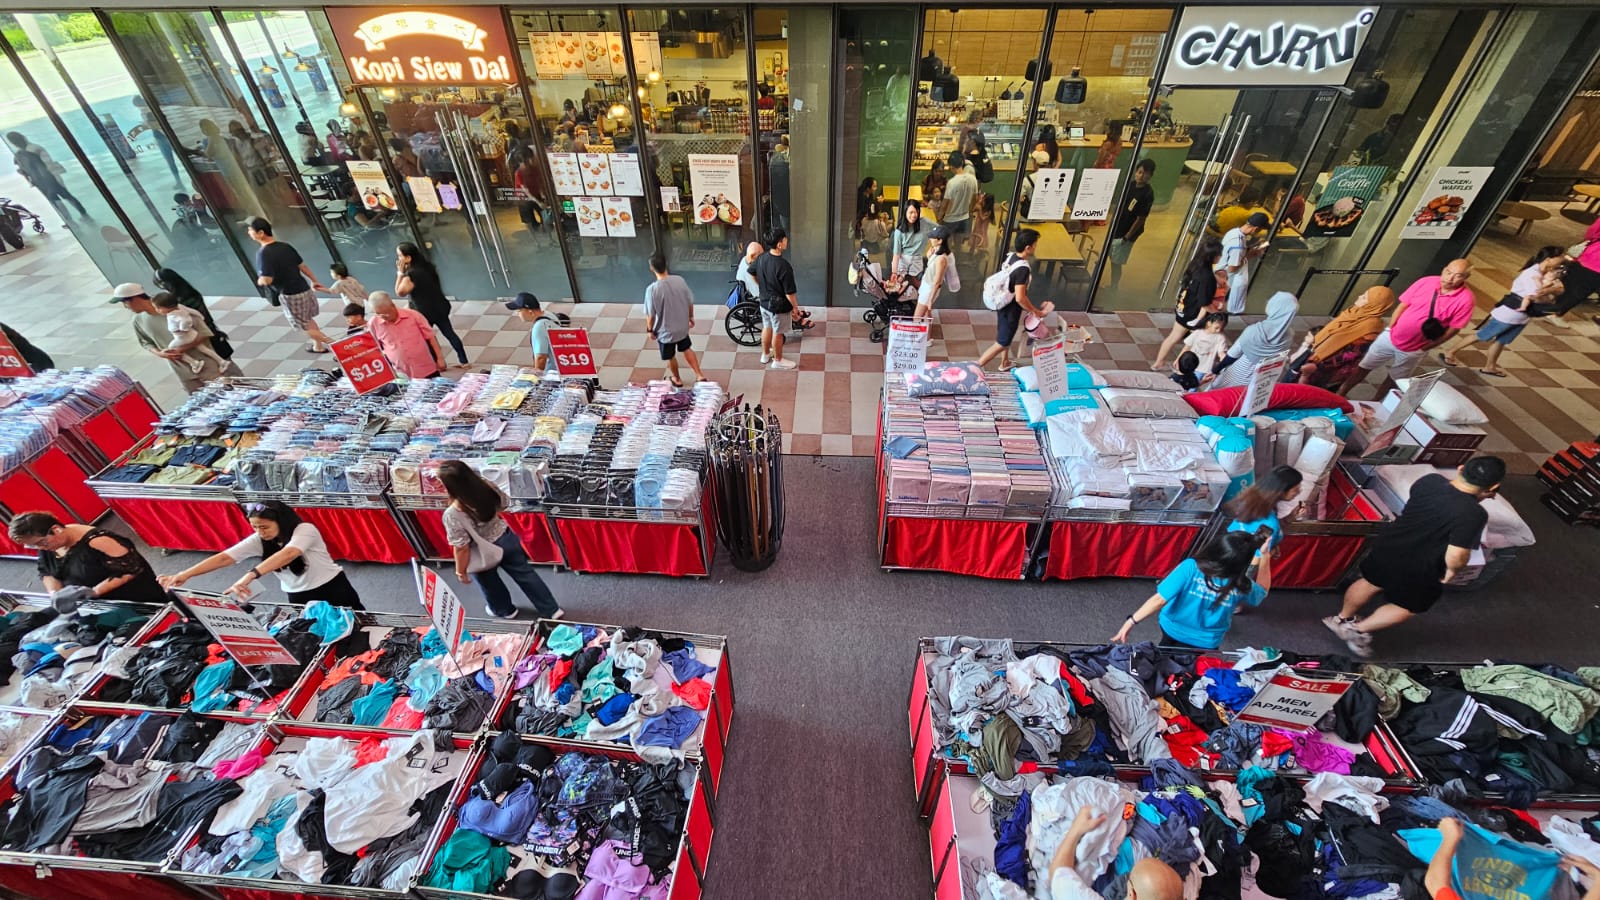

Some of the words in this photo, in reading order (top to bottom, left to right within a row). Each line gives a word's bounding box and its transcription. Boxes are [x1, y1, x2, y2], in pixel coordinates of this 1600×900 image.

[1179, 23, 1359, 71] CHURN
[350, 56, 405, 83] Kopi
[410, 56, 463, 81] Siew
[468, 55, 511, 81] Dai
[557, 352, 590, 367] $19
[350, 359, 385, 382] $19
[425, 579, 436, 609] SALE
[440, 588, 449, 628] WOMEN
[204, 613, 252, 625] WOMEN
[209, 622, 264, 632] APPAREL
[236, 649, 262, 657] LAST
[263, 650, 285, 658] DAY
[1289, 680, 1331, 692] SALE
[1250, 701, 1318, 718] APPAREL
[1277, 696, 1312, 708] MEN
